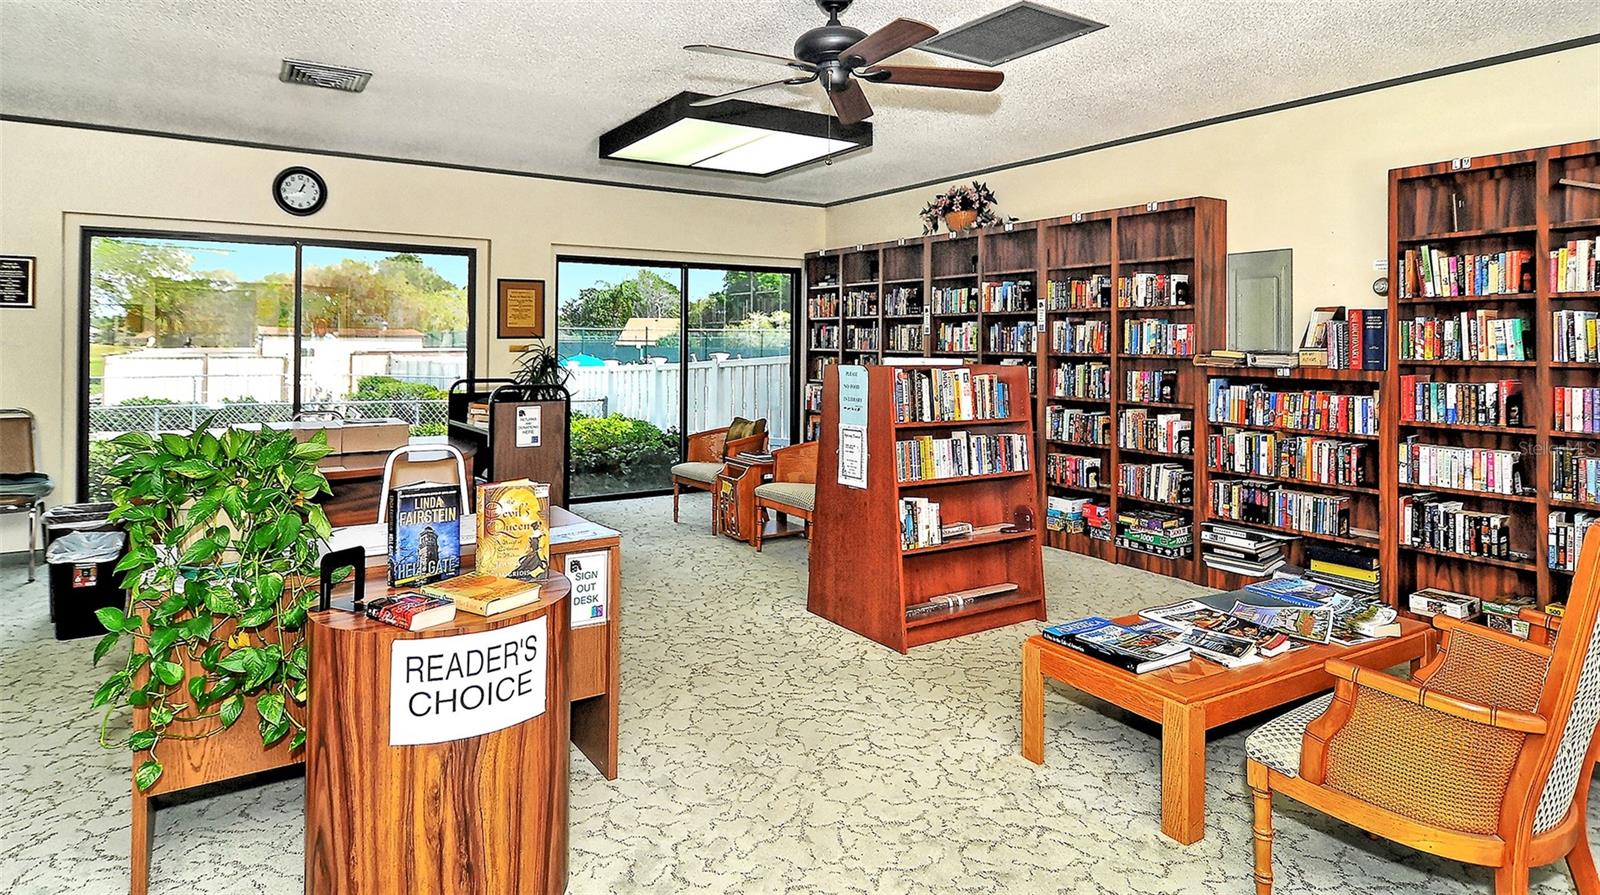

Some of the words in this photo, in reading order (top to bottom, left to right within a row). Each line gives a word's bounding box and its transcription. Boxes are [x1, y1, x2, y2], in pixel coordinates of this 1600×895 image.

[414, 496, 444, 510] LINDA
[485, 501, 530, 519] Devil's
[400, 507, 457, 526] FAIRSTEIN
[486, 518, 531, 540] Queen
[1141, 533, 1154, 543] 1000
[398, 562, 428, 580] HELL
[428, 556, 458, 575] GATE
[575, 571, 599, 581] SIGN
[576, 582, 597, 593] OUT
[573, 594, 599, 606] DESK
[1549, 608, 1561, 616] 500
[406, 635, 537, 683] READER'S
[408, 669, 533, 717] CHOICE
